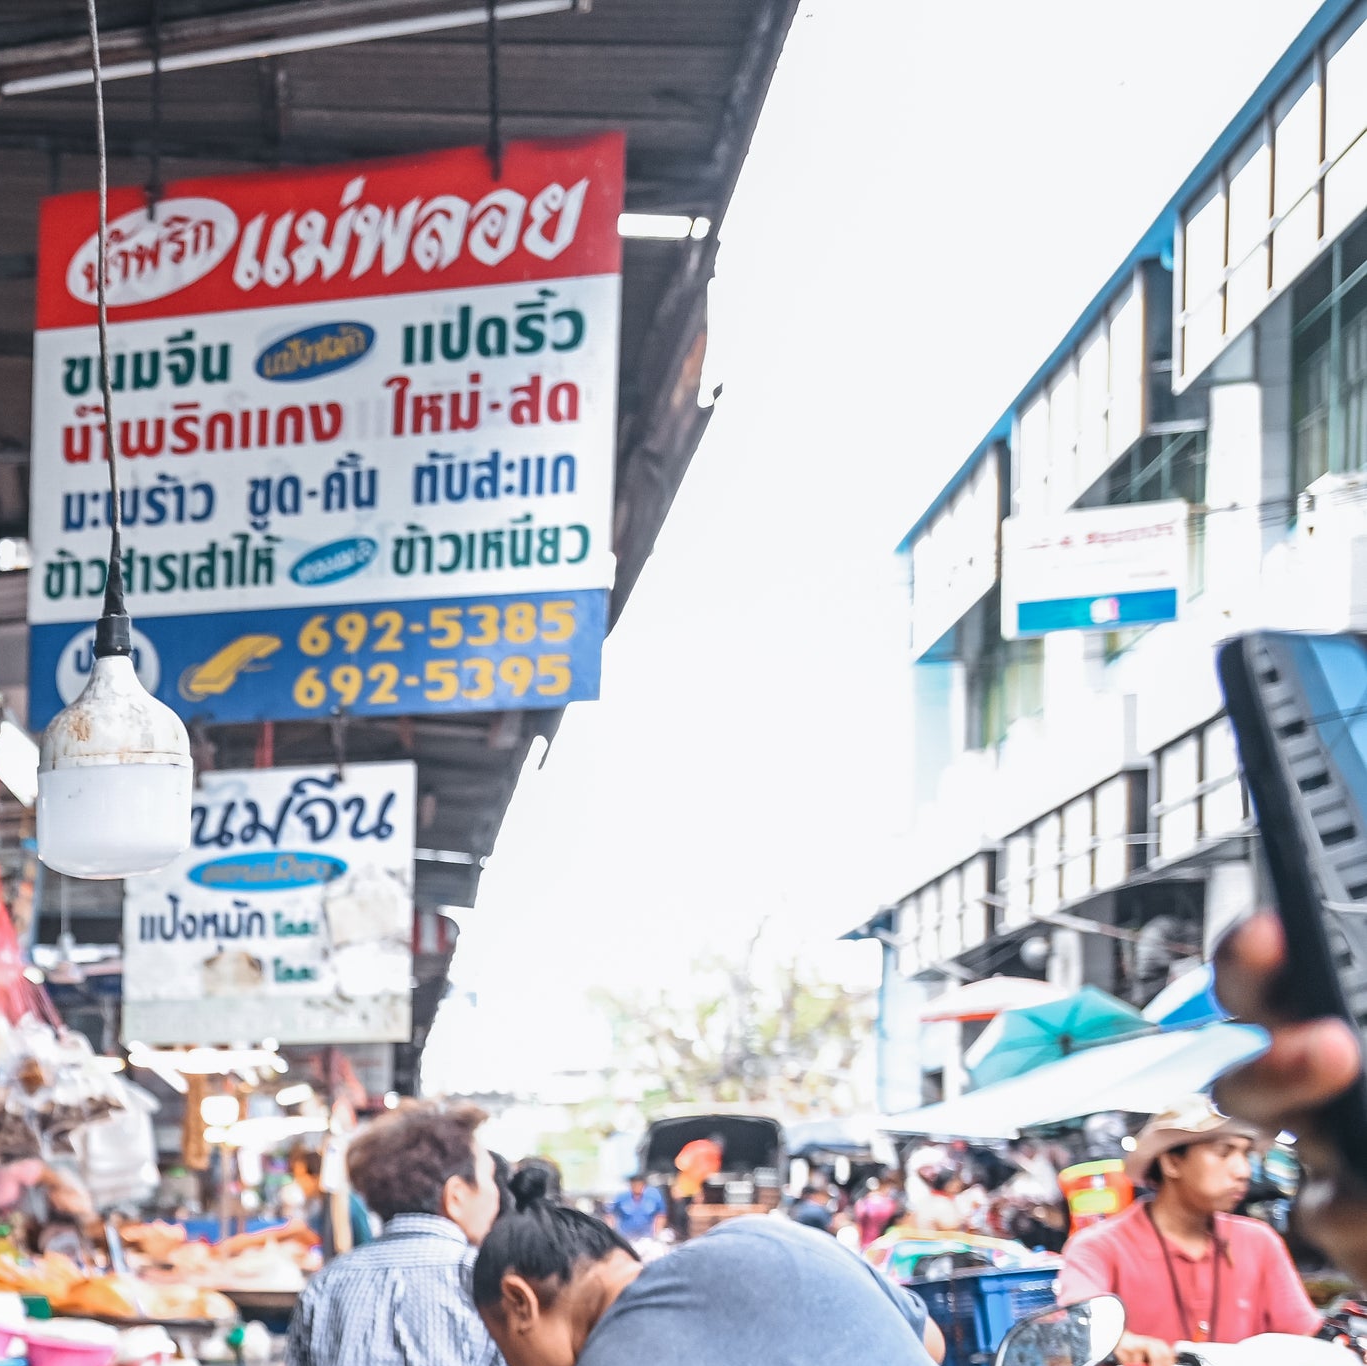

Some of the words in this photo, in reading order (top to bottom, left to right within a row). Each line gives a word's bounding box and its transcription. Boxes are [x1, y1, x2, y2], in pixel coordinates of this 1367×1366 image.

[232, 174, 591, 292] แม่พลอย
[63, 329, 232, 396] ขนมจีน
[403, 289, 585, 364] แปดริ้ว
[63, 472, 215, 531] มะพร้าว
[414, 450, 577, 506] ทับสะแก
[392, 513, 592, 576] ข้าวเหนียว
[297, 600, 576, 657] 692-5385
[293, 654, 573, 708] 692-5395
[191, 772, 397, 849] นมจีน
